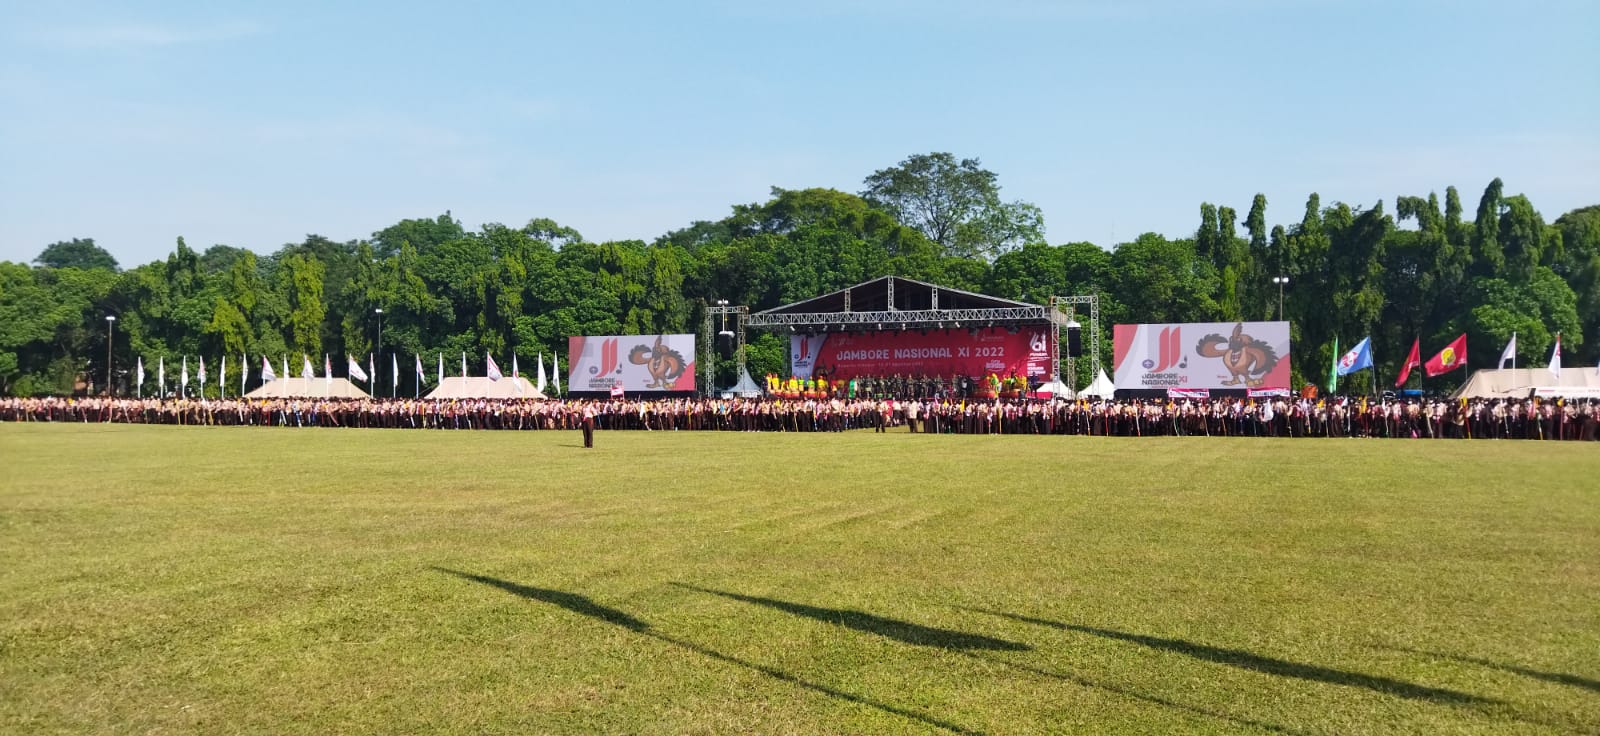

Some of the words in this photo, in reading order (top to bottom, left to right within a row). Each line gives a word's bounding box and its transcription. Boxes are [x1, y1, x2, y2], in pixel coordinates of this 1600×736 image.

[836, 350, 889, 361] JAMBORE
[894, 348, 953, 359] NASIONAL
[958, 346, 970, 358] XI
[975, 346, 1005, 358] 2022
